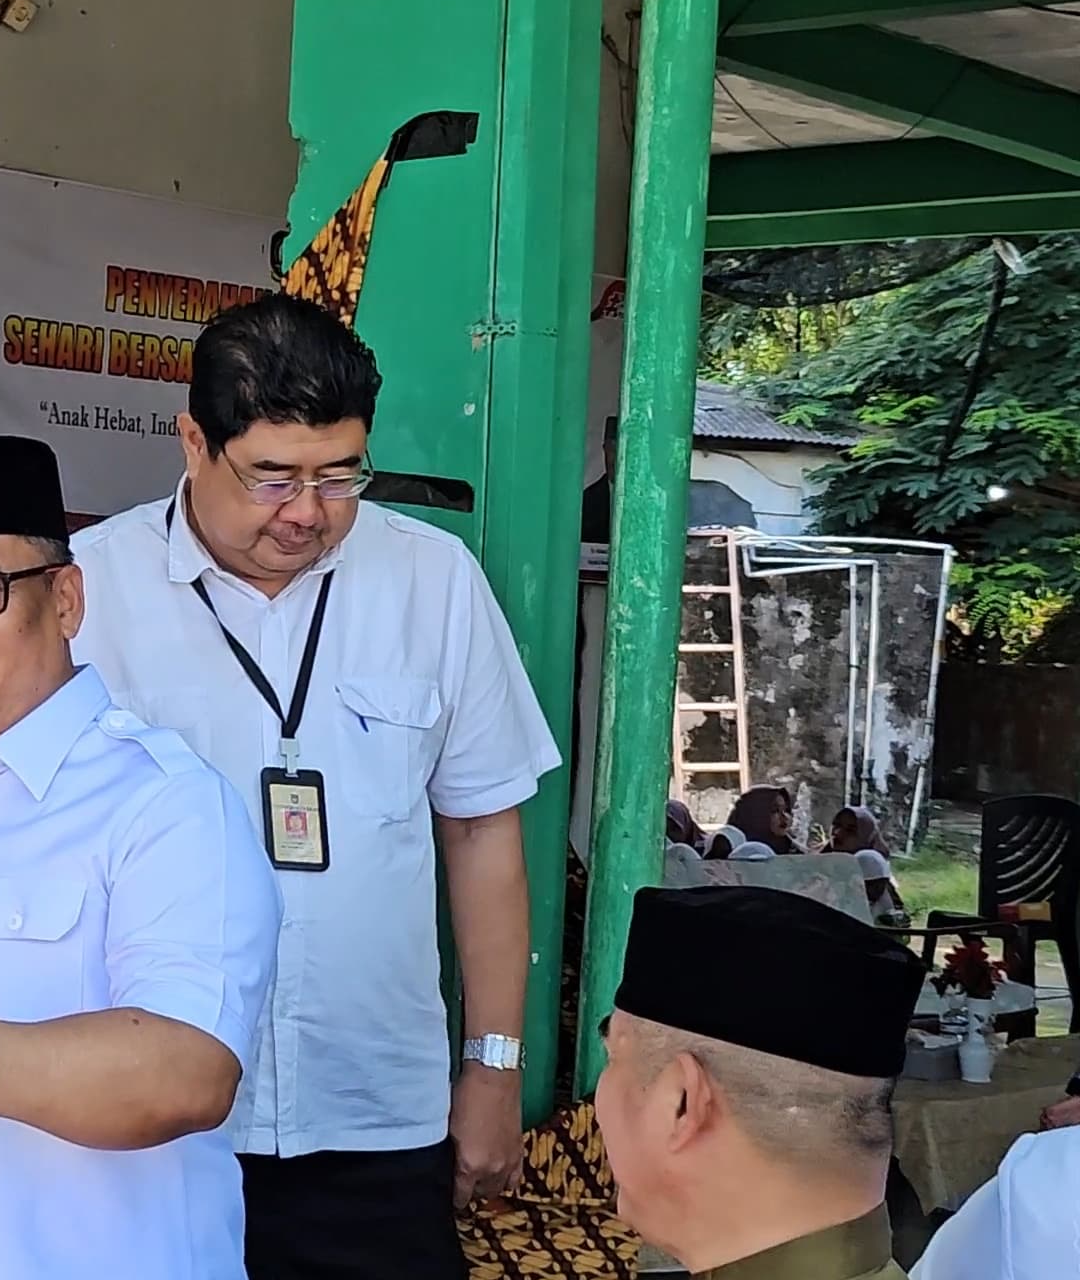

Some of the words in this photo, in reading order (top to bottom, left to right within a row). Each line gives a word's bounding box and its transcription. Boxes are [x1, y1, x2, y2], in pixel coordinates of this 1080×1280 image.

[105, 265, 273, 325] PENYERAH
[3, 315, 104, 373] SEHARI
[94, 406, 145, 439] Hebat,
[150, 412, 181, 438] Ind
